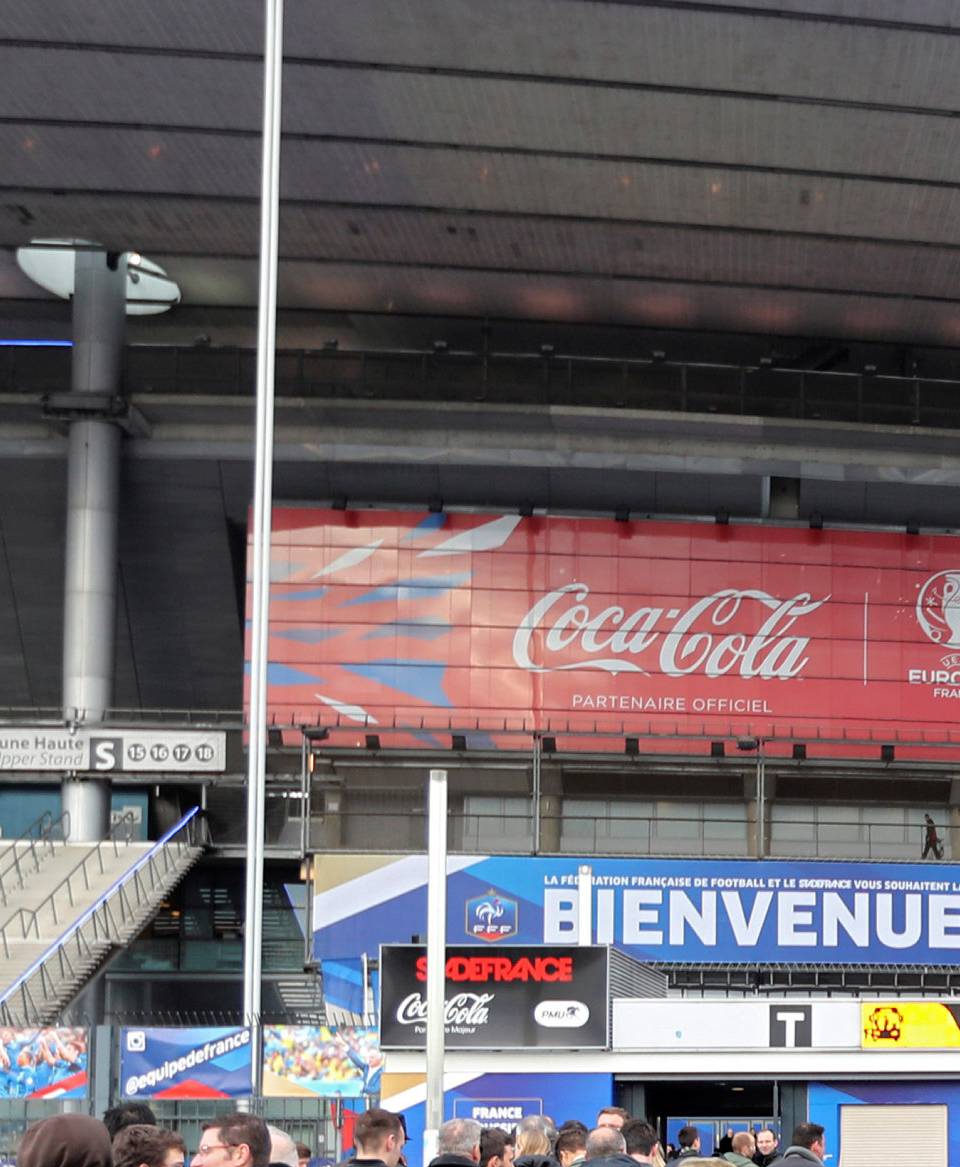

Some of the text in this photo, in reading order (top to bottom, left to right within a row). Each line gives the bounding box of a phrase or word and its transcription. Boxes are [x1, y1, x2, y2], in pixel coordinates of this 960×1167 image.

[512, 582, 832, 680] Coca-Cola
[572, 694, 773, 713] PARTENAIRE OFFICIEL
[35, 736, 84, 751] Haute
[0, 752, 84, 768] pper Stand
[95, 741, 213, 769] S 15 16 17 18
[544, 875, 558, 885] LA
[631, 876, 692, 888] FRANÇAISE
[694, 877, 708, 887] DE
[711, 878, 766, 888] FOOTBALL
[768, 878, 781, 888] ET
[783, 878, 796, 888] LE
[854, 879, 882, 889] VOUS
[885, 880, 950, 891] SOUHAITENT
[415, 956, 573, 982] SADEFRANCE
[451, 1026, 476, 1035] Majeur
[776, 1012, 805, 1048] T
[125, 1029, 250, 1096] @equipedefrance
[472, 1106, 523, 1119] FRANCE
